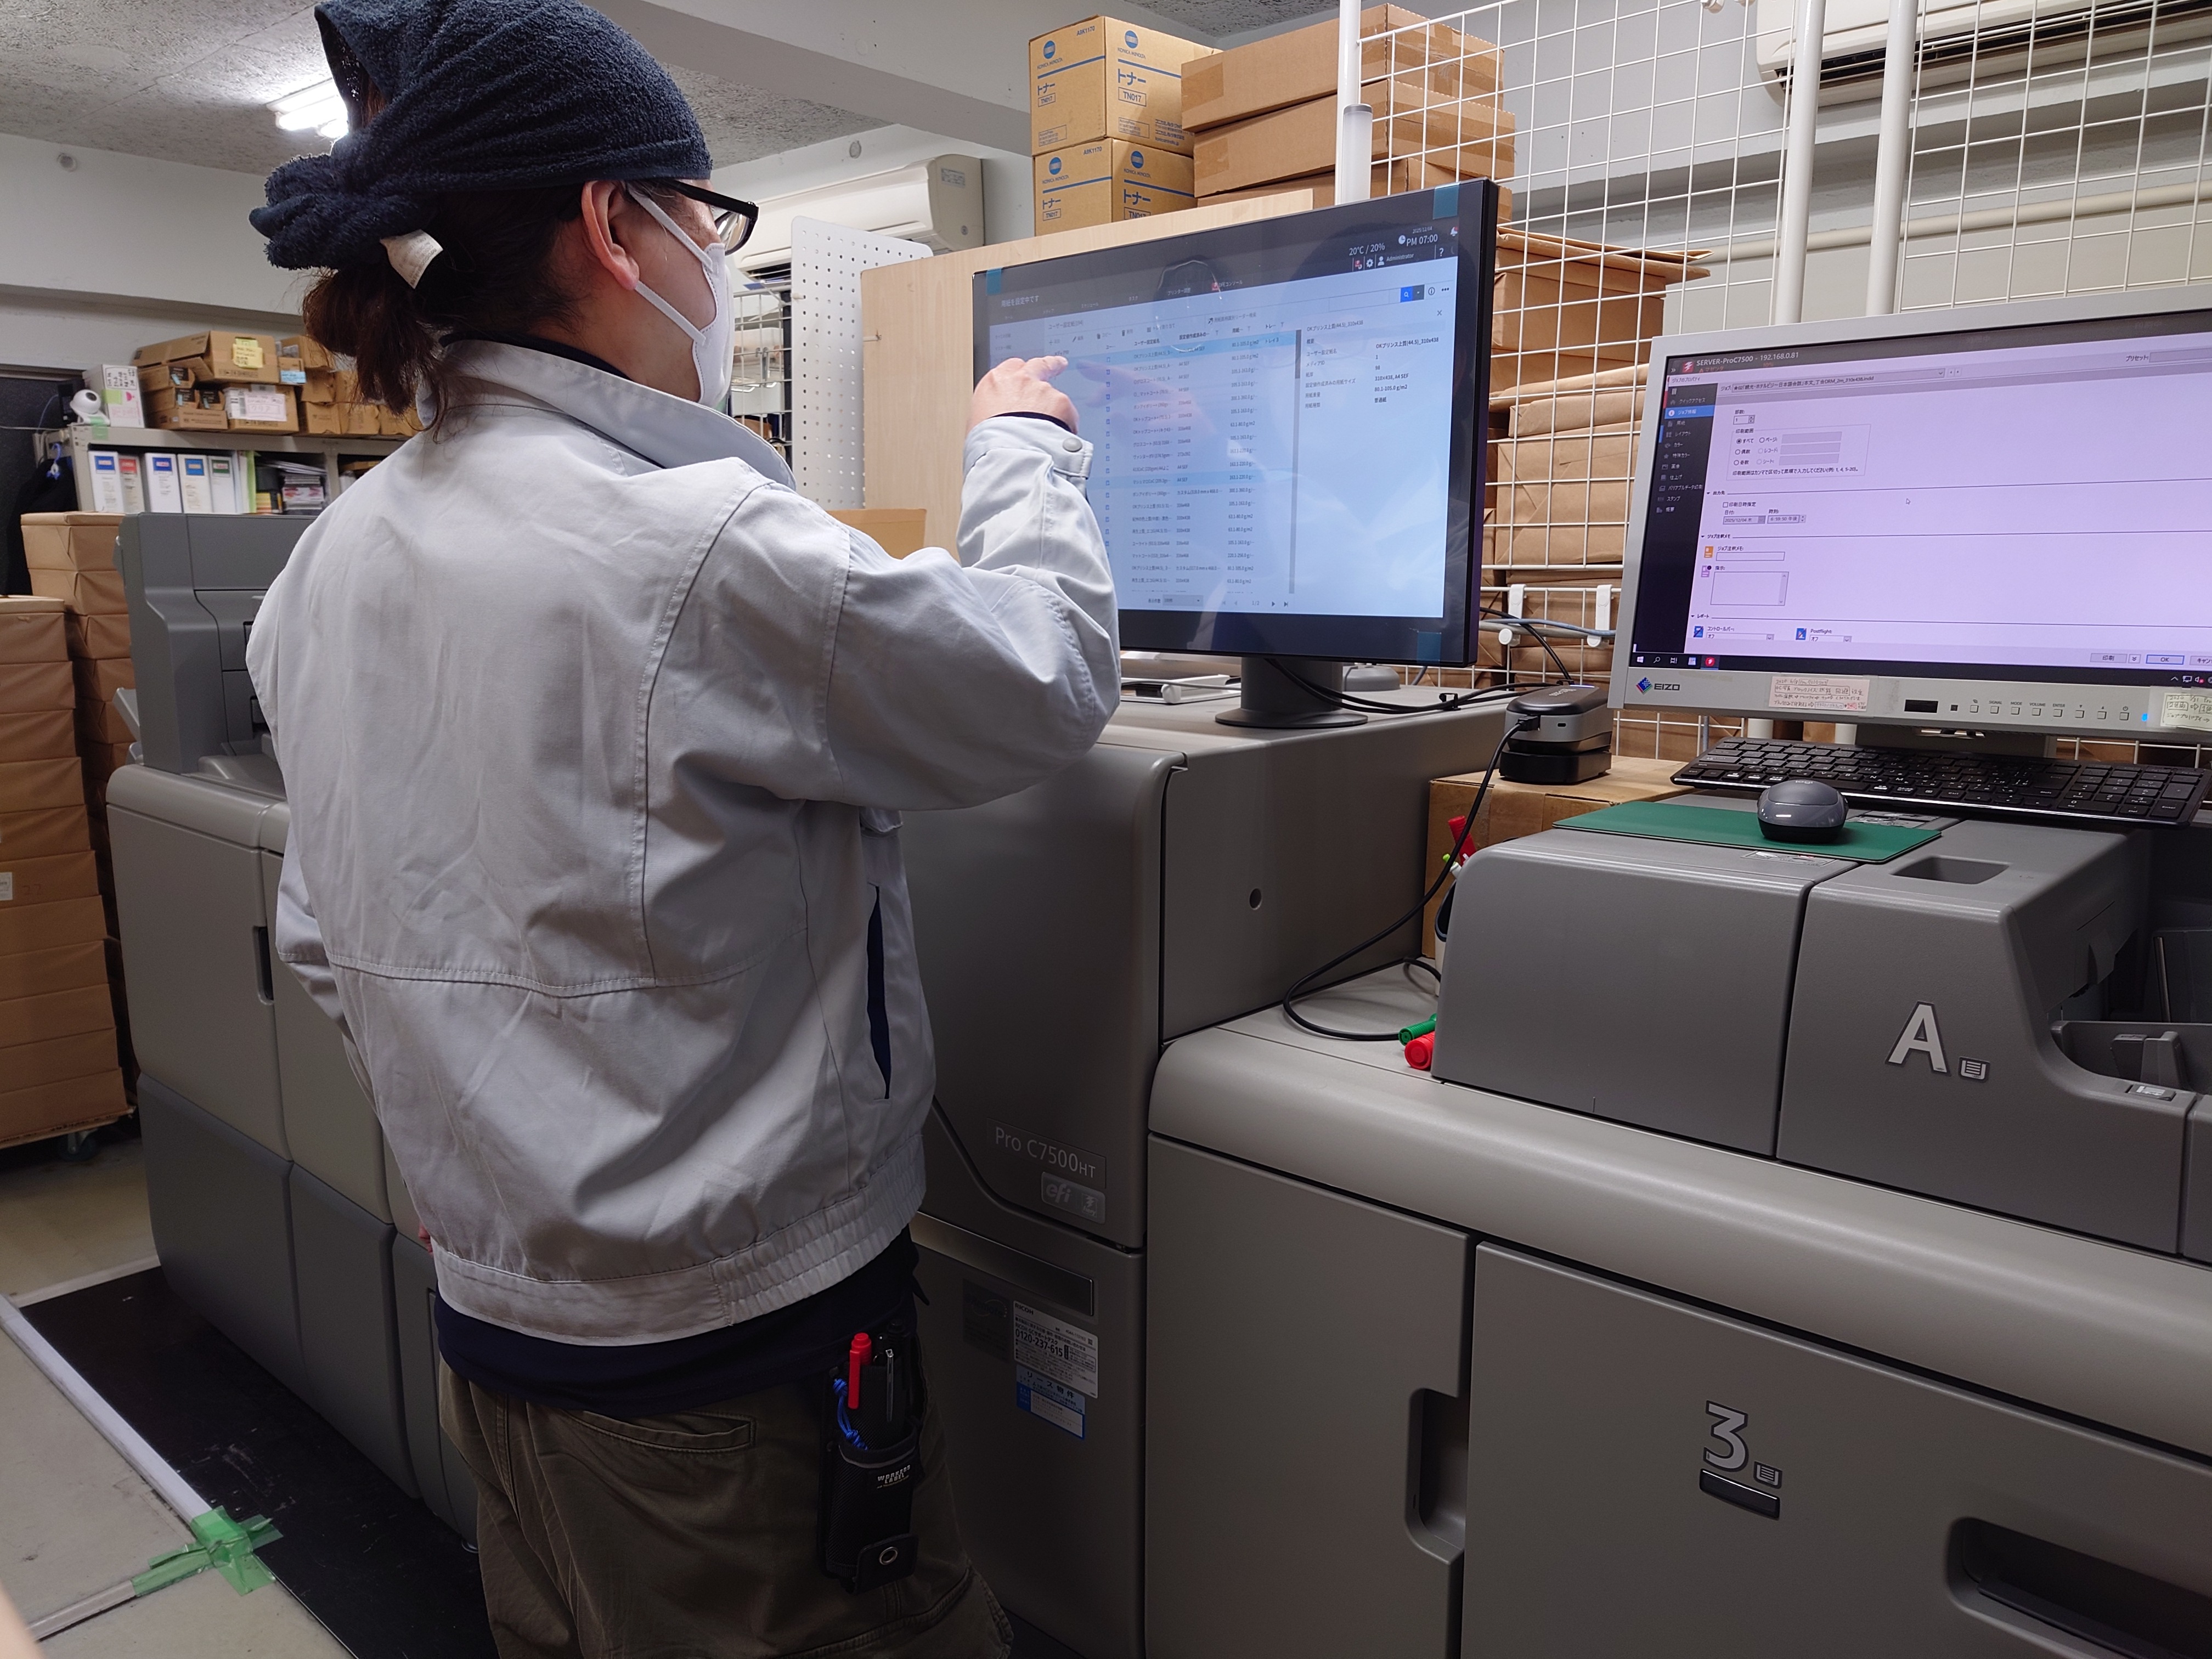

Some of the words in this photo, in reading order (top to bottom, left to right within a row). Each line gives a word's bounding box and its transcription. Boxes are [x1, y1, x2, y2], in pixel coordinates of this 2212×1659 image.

[1076, 25, 1096, 37] A9K1170
[1117, 47, 1131, 55] KONICA
[1131, 50, 1146, 60] MINOLTA
[1037, 61, 1048, 70] KONICA
[1048, 58, 1063, 67] MINOLTA
[1118, 68, 1147, 86] トナー
[1037, 82, 1056, 96] トナー
[1041, 95, 1053, 104] TN017
[1123, 91, 1142, 103] TN017
[1083, 146, 1102, 156] A9K1170
[1055, 174, 1069, 182] MINOLTA
[1137, 170, 1151, 179] MINOLTA
[1124, 189, 1151, 205] トナー
[1042, 198, 1061, 210] トナー
[1046, 211, 1058, 219] TN017
[1406, 238, 1417, 247] PM
[1419, 233, 1438, 245] 07:00
[1370, 242, 1385, 252] 20%
[1386, 253, 1414, 262] Administrator
[1001, 295, 1040, 308] 用紙を設定中です
[1375, 337, 1439, 349] OKプリンス上質(44.5)_310x438
[1696, 356, 1753, 366] SERVER-ProC7500
[1760, 352, 1799, 361] 192.168.0.81
[2125, 354, 2149, 362] プリセット:
[1654, 683, 1680, 691] EIZO
[1886, 1002, 1950, 1075] A
[996, 1126, 1021, 1152] Pro
[1027, 1139, 1096, 1178] C7500HT
[1046, 1183, 1071, 1204] efi
[1015, 1302, 1034, 1316] RICOH
[1015, 1328, 1063, 1357] 0120-237-615
[1026, 1371, 1075, 1400] リース物件
[1703, 1400, 1748, 1472] 3
[877, 1464, 911, 1482] WORKERS
[884, 1472, 905, 1484] LABEL
